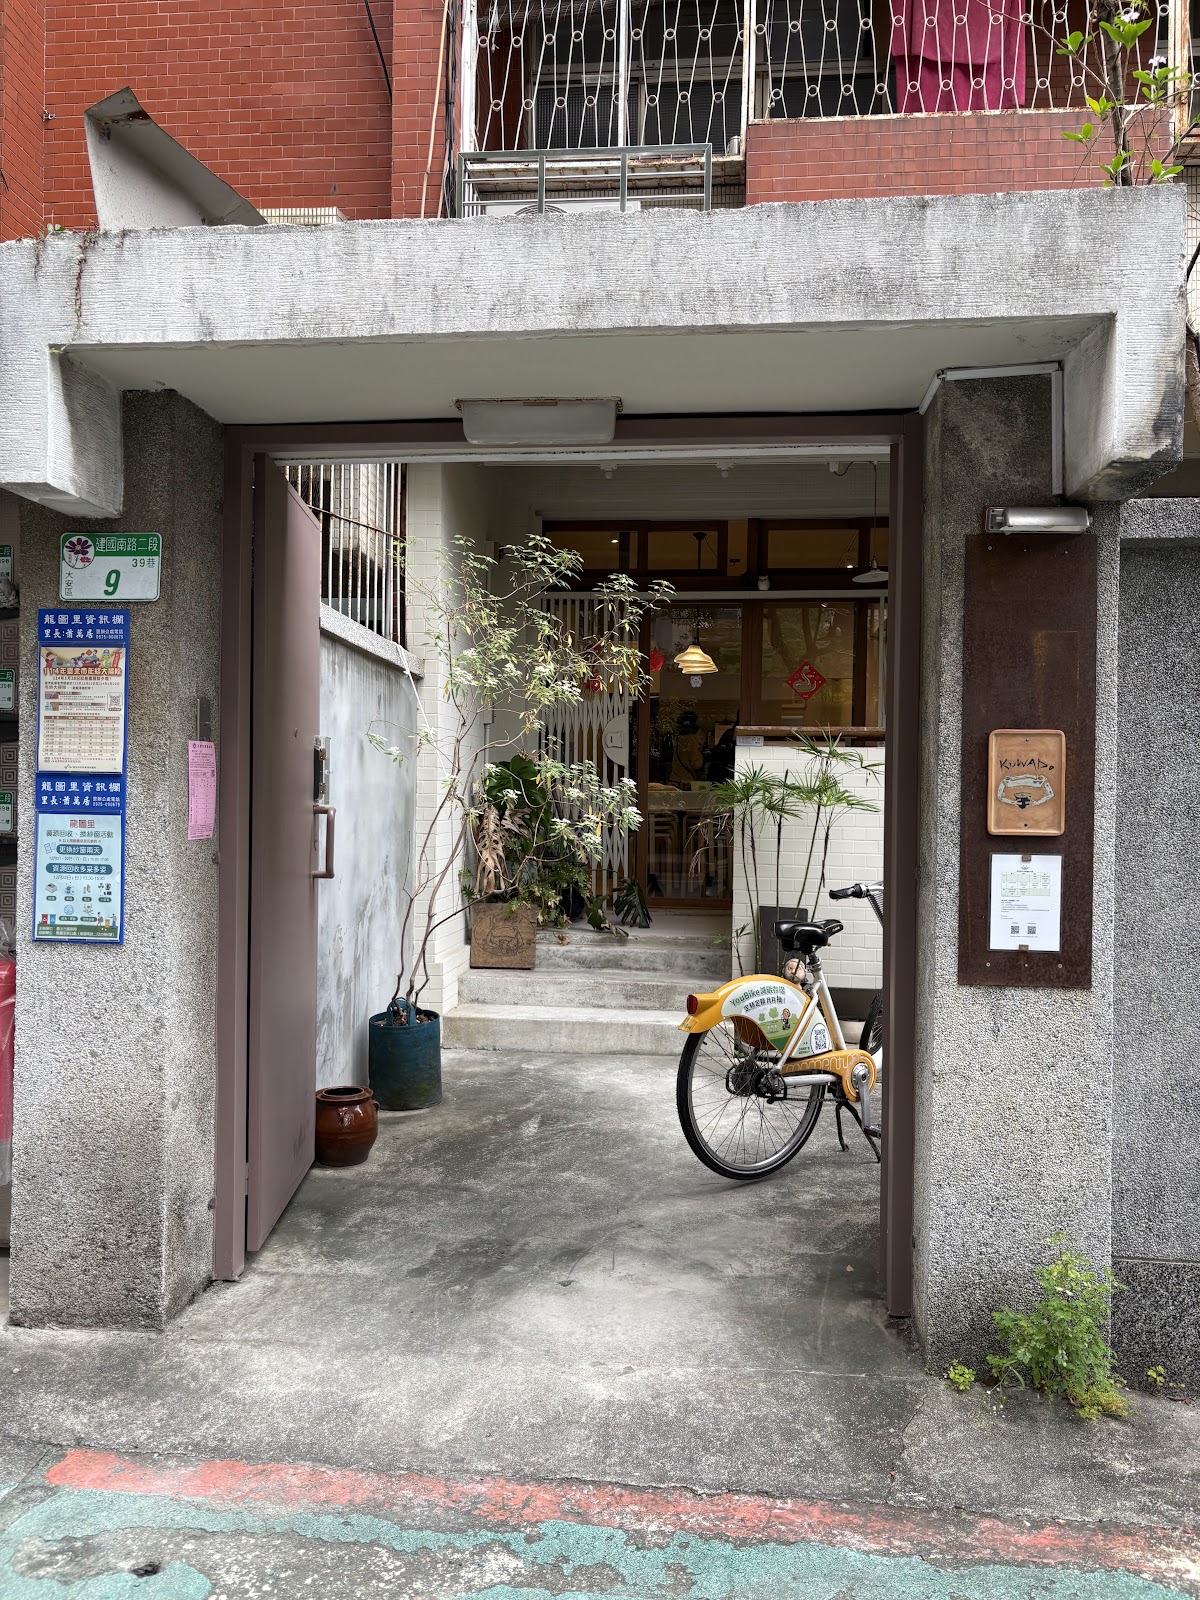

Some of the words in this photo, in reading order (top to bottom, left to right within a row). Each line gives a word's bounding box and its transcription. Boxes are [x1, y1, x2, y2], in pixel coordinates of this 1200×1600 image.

[95, 536, 159, 552] 建國南路二段
[131, 558, 156, 568] 39巷
[64, 571, 74, 597] 大安區
[103, 569, 121, 596] 9
[44, 614, 124, 625] 龍圖里資訊欄
[41, 781, 121, 792] 龍圖里資訊欄
